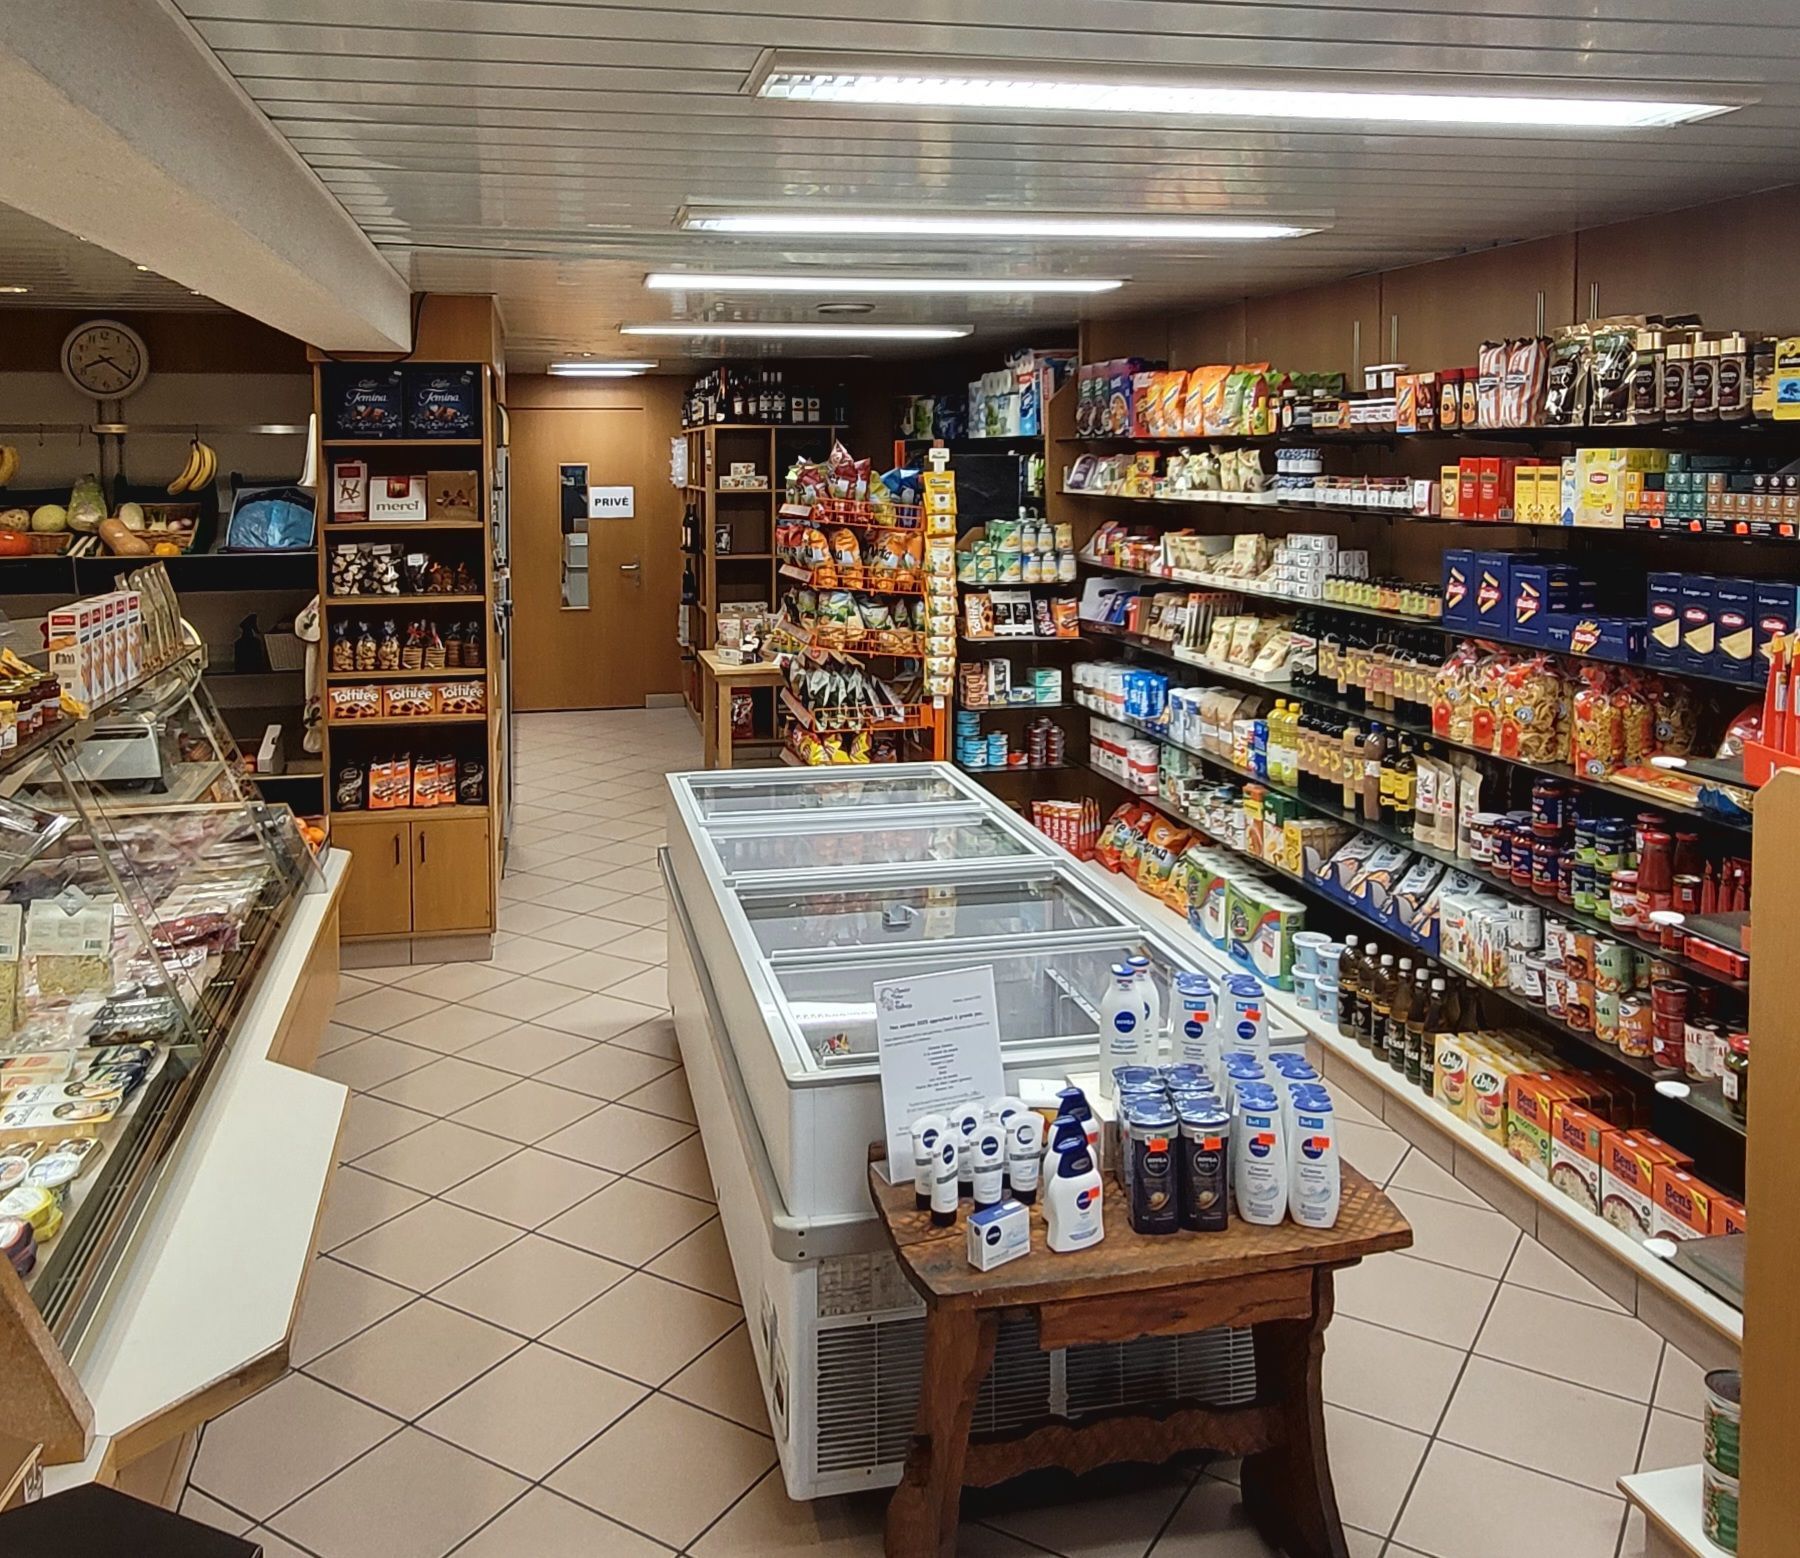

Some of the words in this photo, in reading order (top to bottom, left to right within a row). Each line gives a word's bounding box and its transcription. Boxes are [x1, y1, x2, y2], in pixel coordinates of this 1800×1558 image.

[376, 500, 420, 512] merci
[594, 496, 630, 507] PRIVÉ
[331, 688, 379, 704] Toffifee
[386, 686, 432, 702] Toffifee
[438, 684, 484, 700] Toffifee
[1517, 1087, 1537, 1111] Ben's
[1562, 1118, 1586, 1142] Ben's
[1614, 1148, 1638, 1174] Ben's
[1666, 1183, 1692, 1210] Ben's
